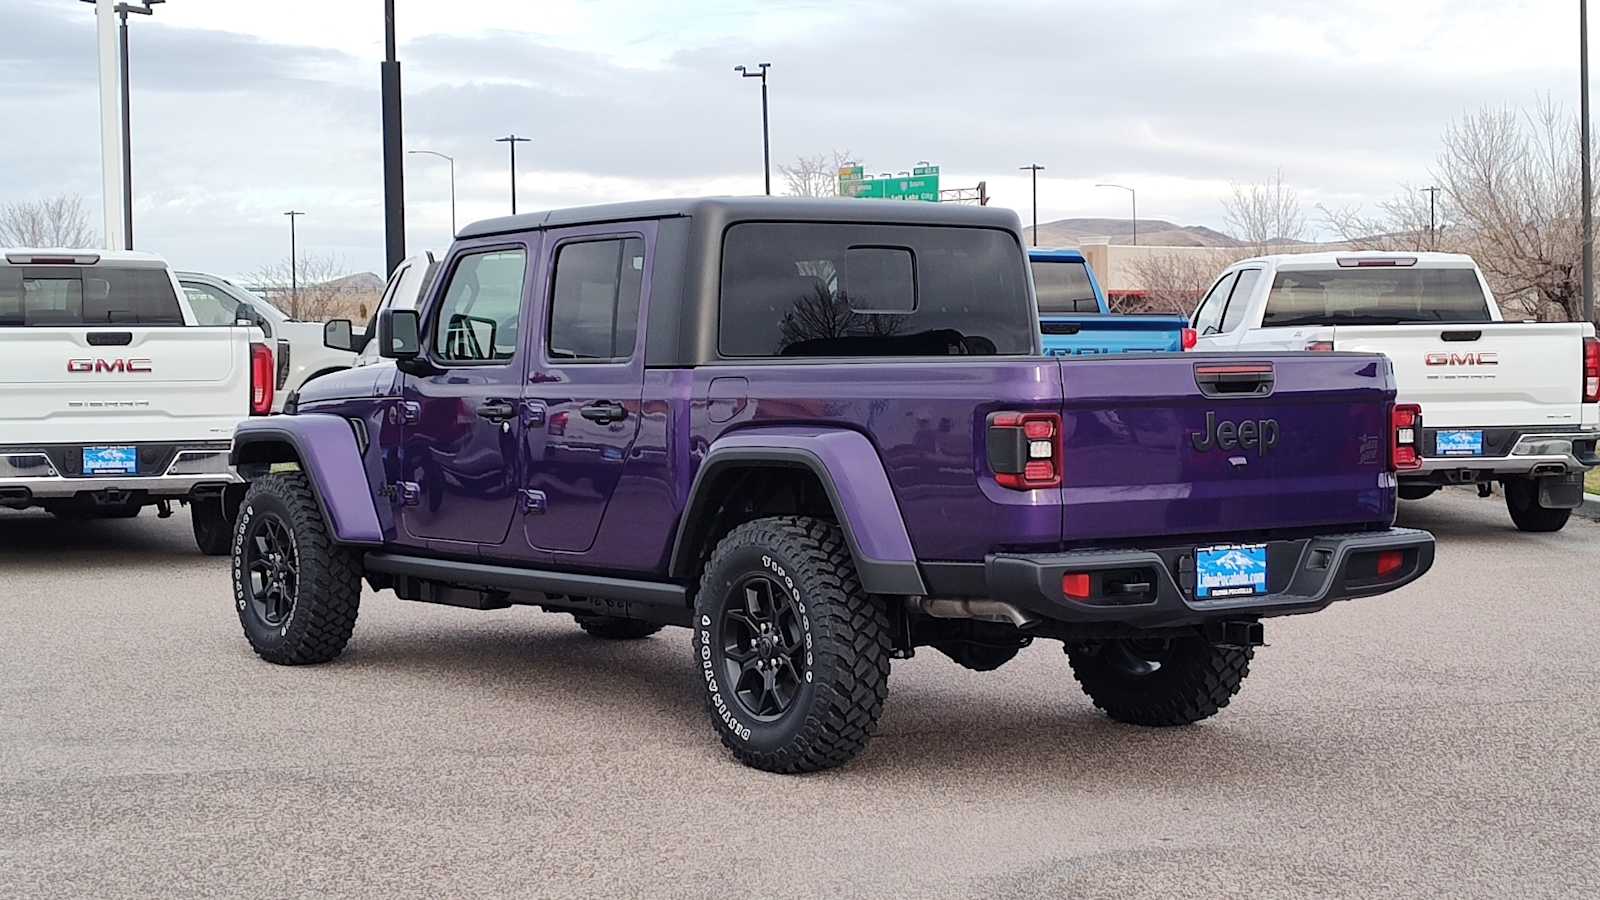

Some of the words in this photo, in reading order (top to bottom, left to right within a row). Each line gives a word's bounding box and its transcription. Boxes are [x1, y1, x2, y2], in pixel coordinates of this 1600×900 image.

[67, 358, 152, 373] GMC
[1425, 352, 1498, 366] GMC
[1191, 411, 1280, 457] Jeep
[700, 630, 752, 741] DESTINATION
